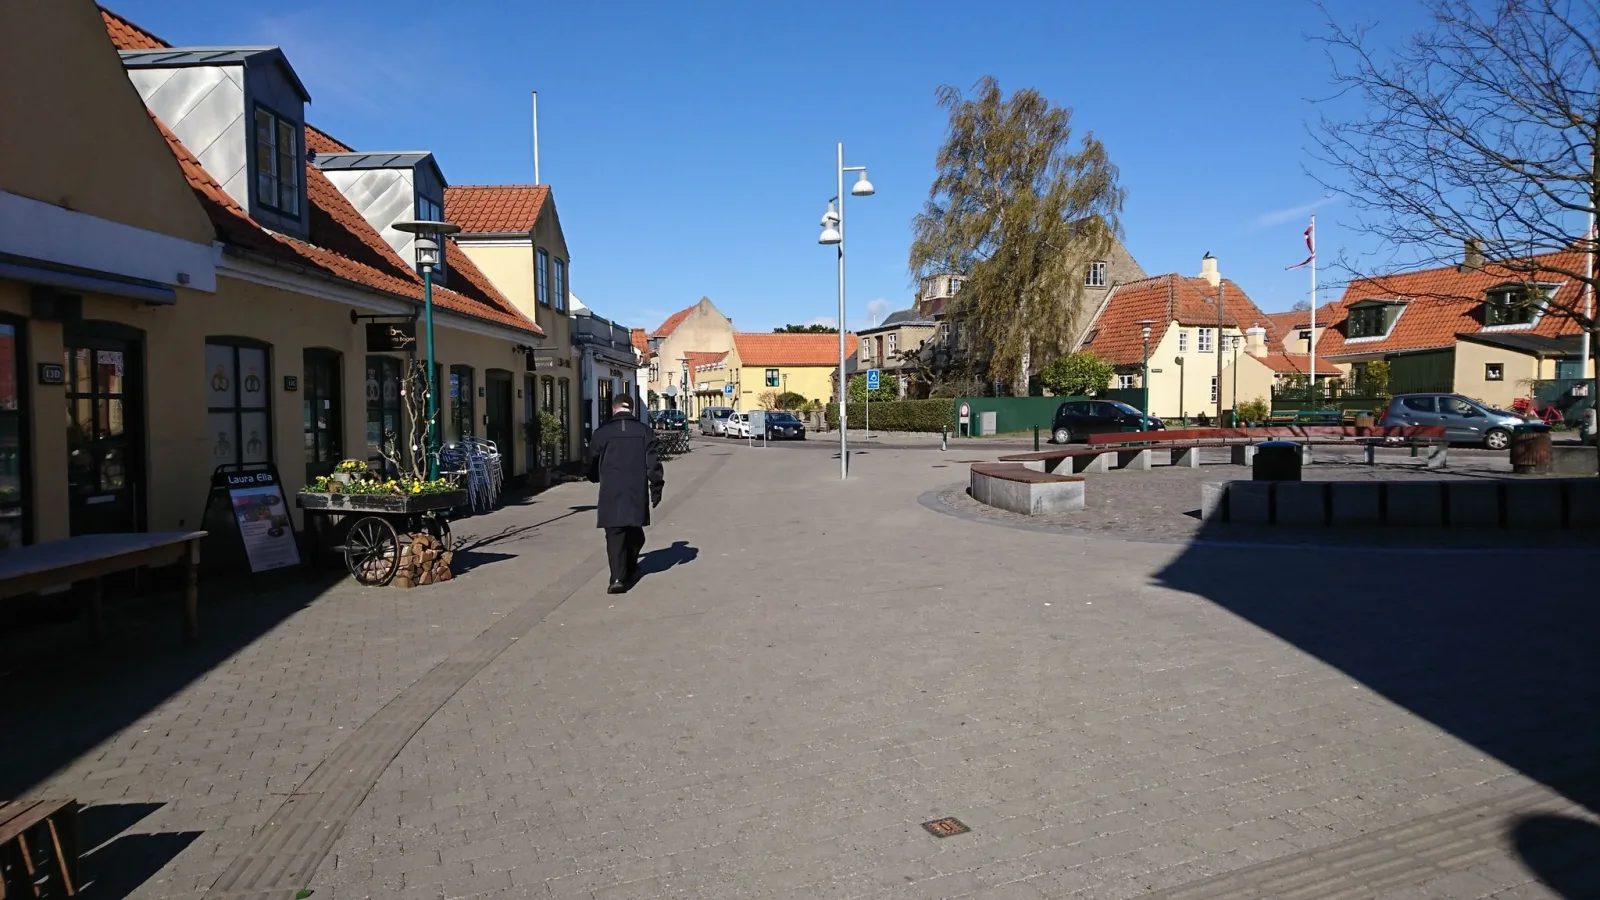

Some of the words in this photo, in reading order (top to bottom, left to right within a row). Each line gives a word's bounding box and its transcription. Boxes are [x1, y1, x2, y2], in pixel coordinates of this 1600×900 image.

[46, 369, 61, 379] 13D
[227, 475, 255, 485] Laura
[256, 473, 273, 482] Ella
